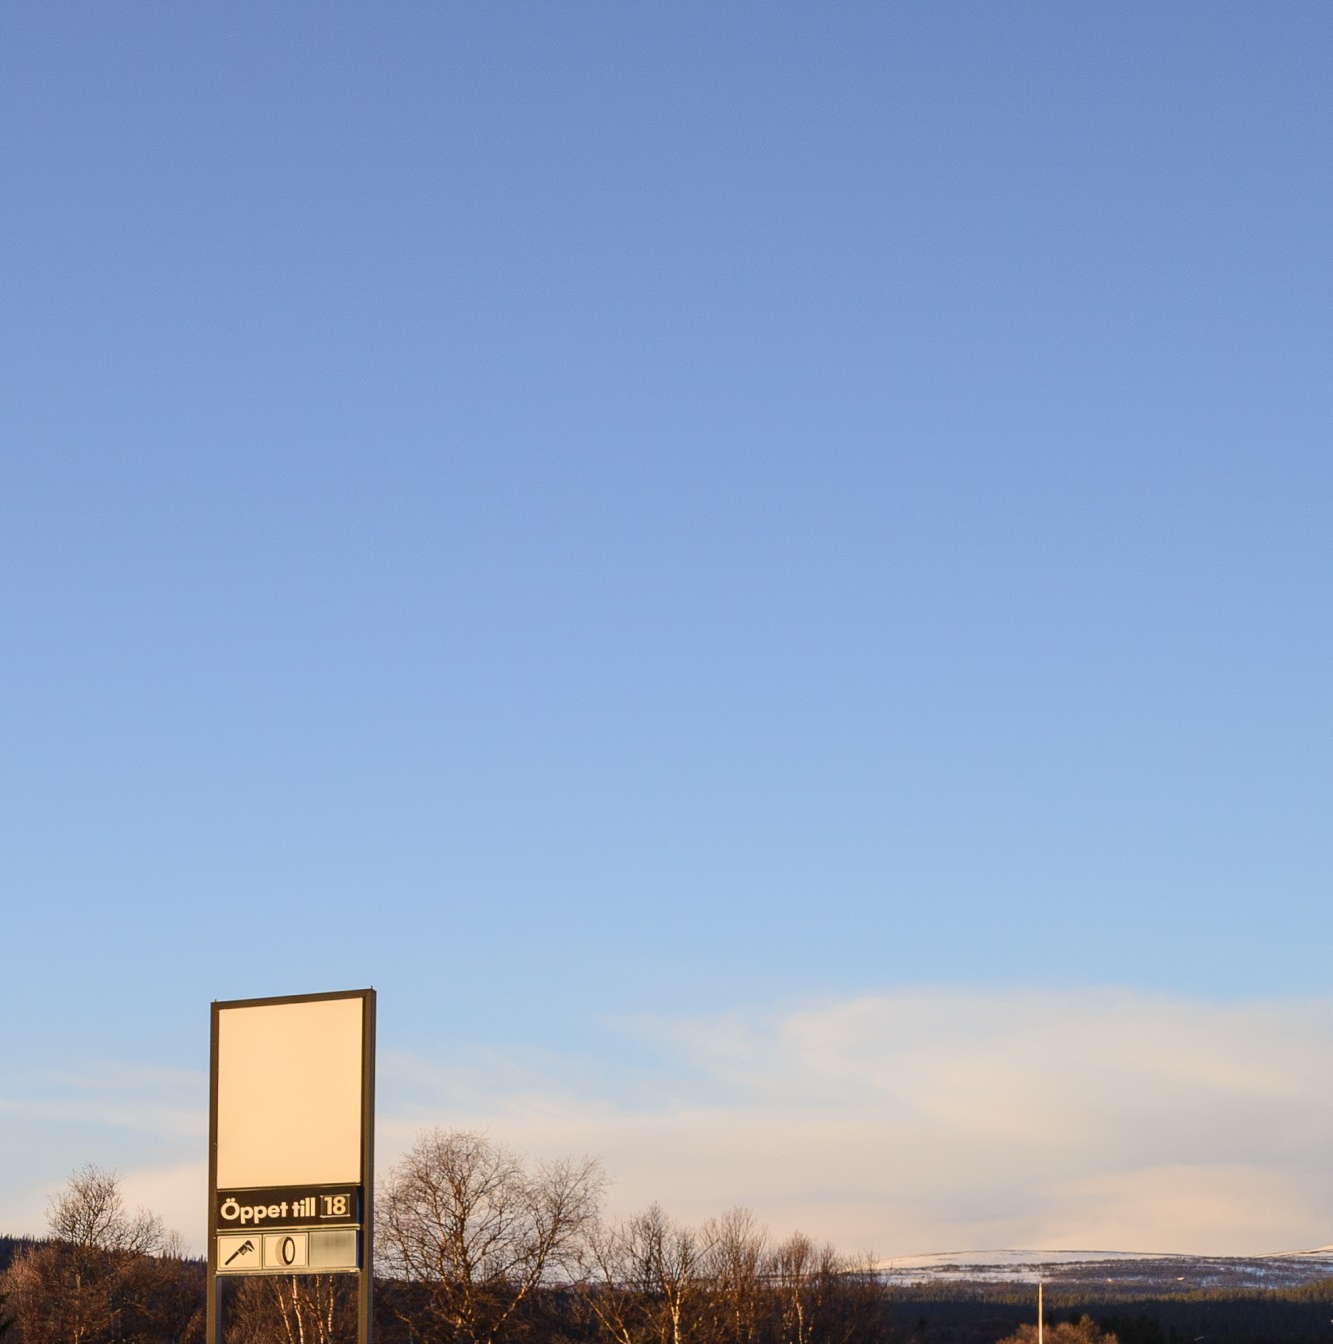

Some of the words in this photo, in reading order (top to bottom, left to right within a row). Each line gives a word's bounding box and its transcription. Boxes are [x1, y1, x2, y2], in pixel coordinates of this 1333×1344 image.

[220, 1197, 289, 1225] Öppet
[292, 1197, 316, 1218] till
[323, 1196, 347, 1216] 18
